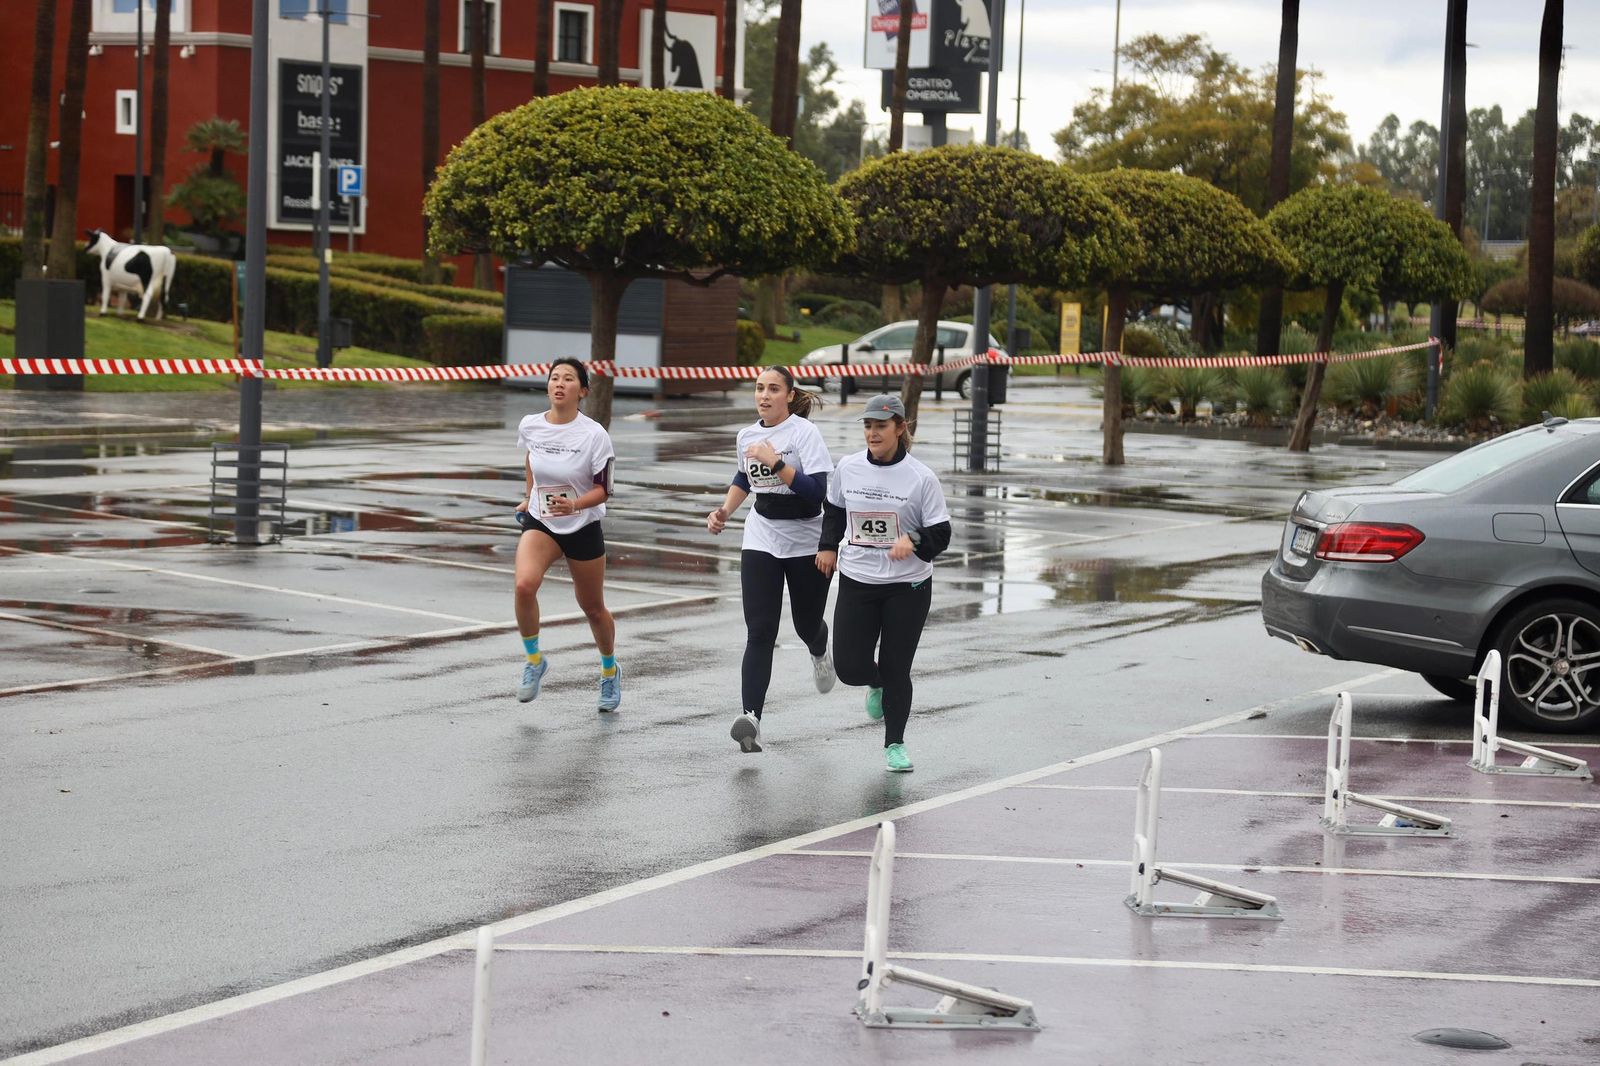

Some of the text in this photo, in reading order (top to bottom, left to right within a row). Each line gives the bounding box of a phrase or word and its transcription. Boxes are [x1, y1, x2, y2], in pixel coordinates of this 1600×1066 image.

[908, 77, 952, 89] CENTRO
[905, 89, 961, 101] OMERCIAL
[342, 168, 357, 192] P
[861, 520, 888, 534] 43
